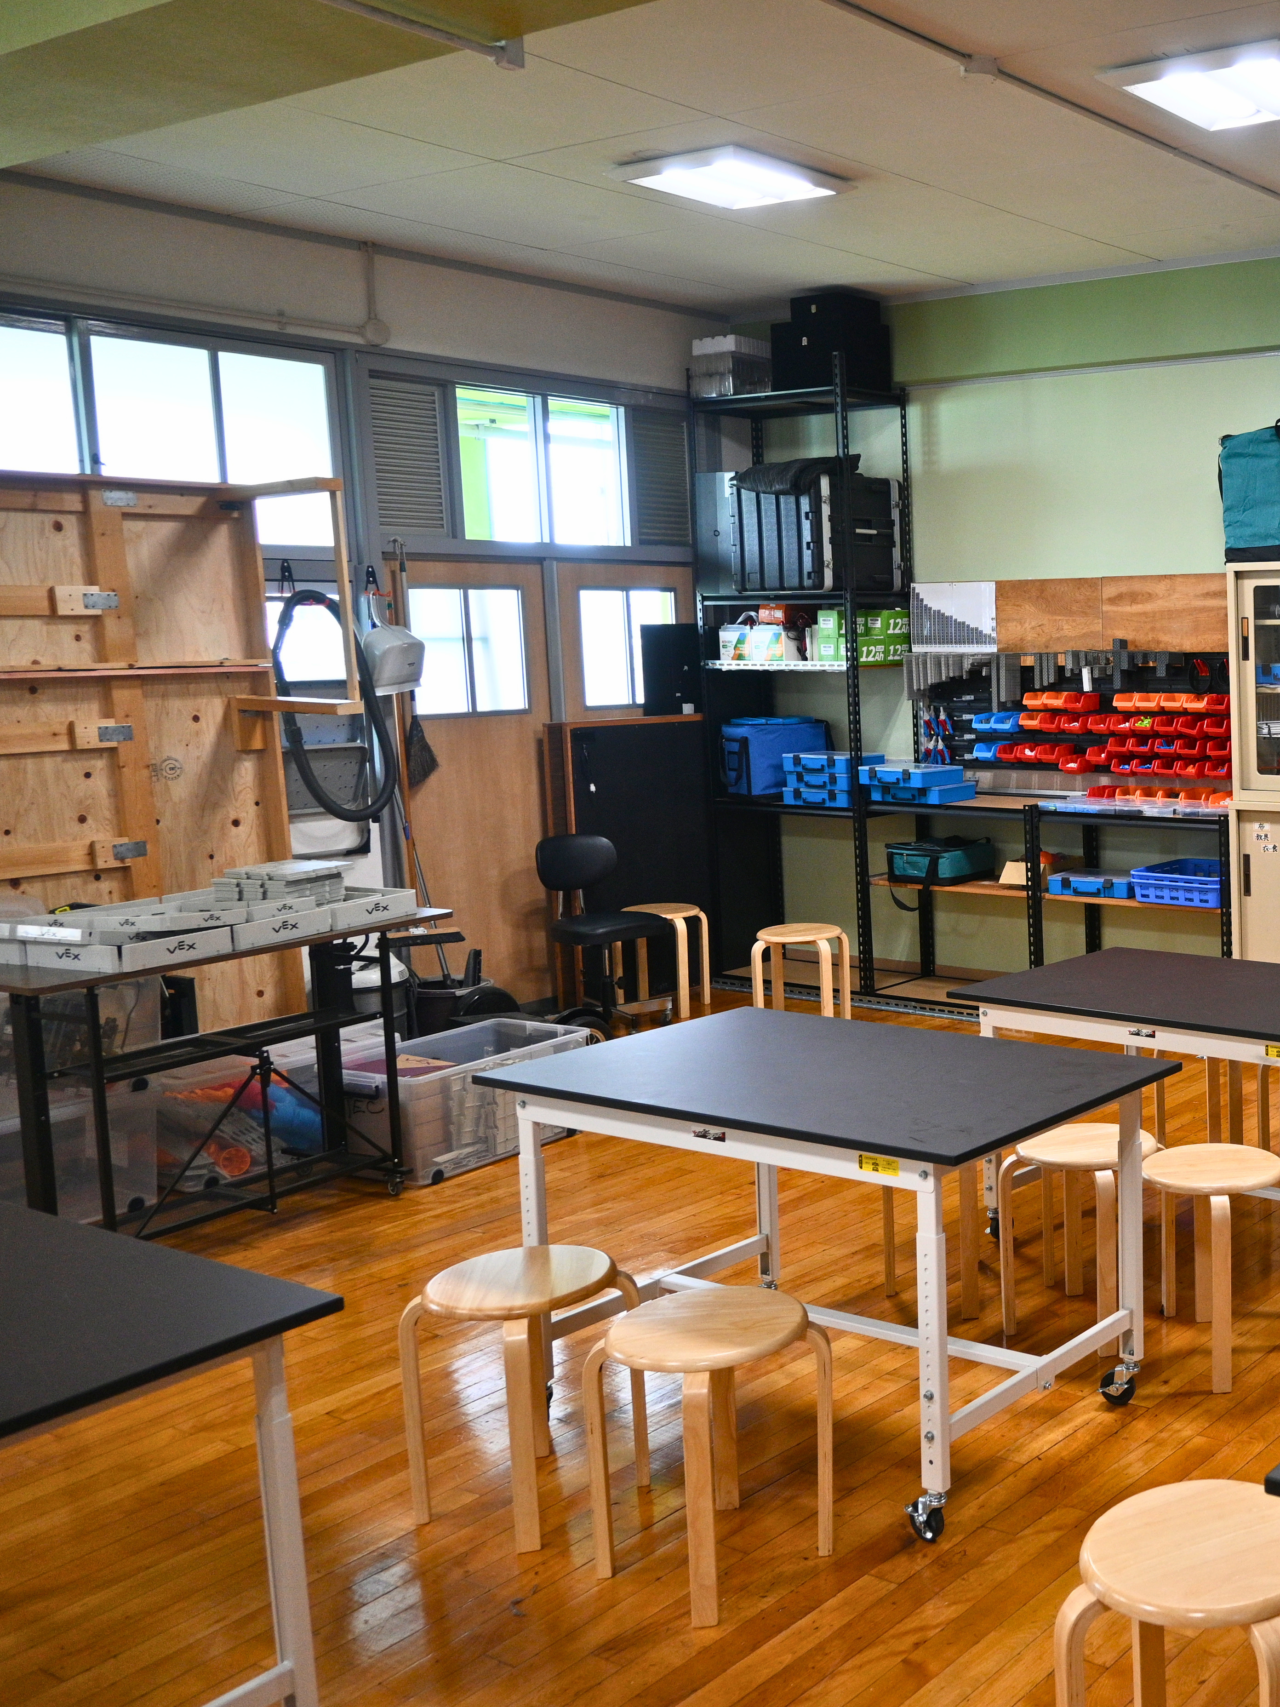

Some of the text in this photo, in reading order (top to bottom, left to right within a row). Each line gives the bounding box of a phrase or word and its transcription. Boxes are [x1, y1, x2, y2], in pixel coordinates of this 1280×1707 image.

[860, 645, 884, 661] 12Ah
[277, 903, 293, 912] VEX
[366, 903, 389, 914] VEX
[48, 919, 64, 927] VEX
[119, 919, 136, 927] VEX
[203, 914, 221, 922] VEX
[272, 920, 299, 933] VEX
[166, 940, 197, 954] VEX
[56, 948, 81, 961] VEX
